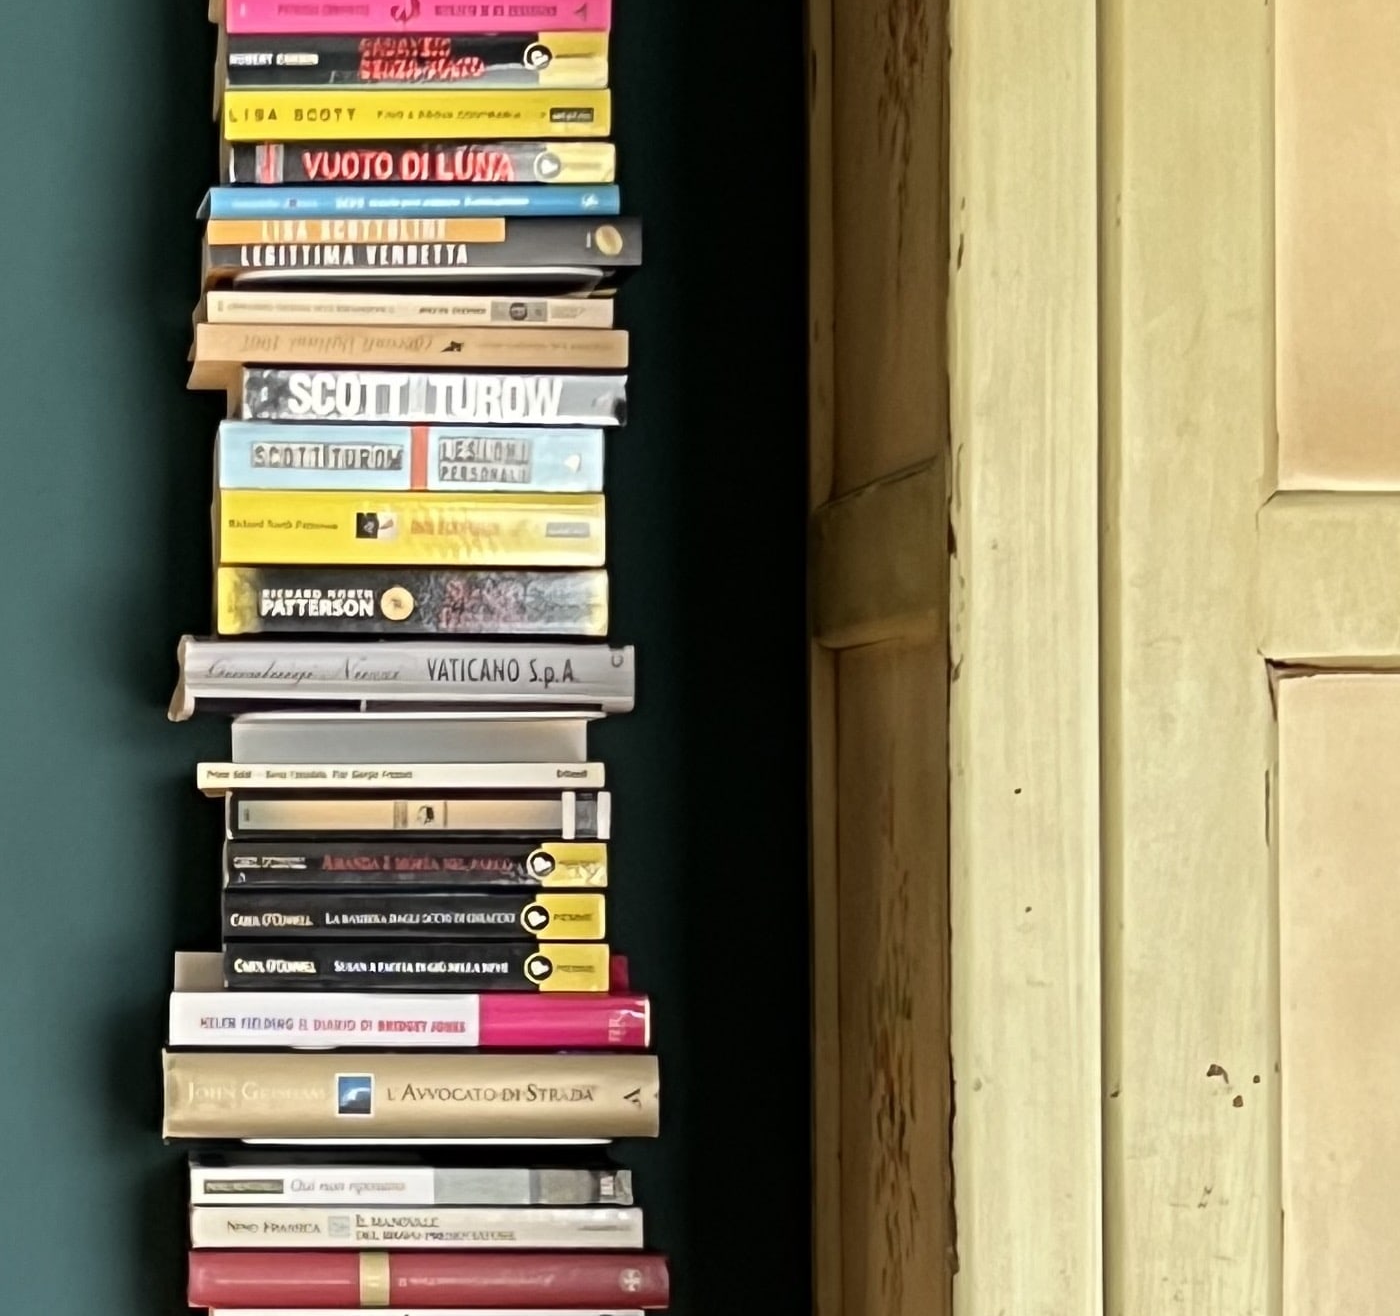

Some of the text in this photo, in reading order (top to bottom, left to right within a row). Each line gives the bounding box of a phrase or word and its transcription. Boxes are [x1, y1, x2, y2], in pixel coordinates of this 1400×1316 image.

[229, 108, 356, 122] LISA SCOTT
[303, 149, 515, 182] VUOTO DI LUNA
[240, 244, 468, 267] LEGITTIMA VENDETTA
[287, 372, 563, 418] SCOTT TUROW
[254, 445, 404, 470] SCOTT TUROW
[440, 465, 528, 483] PERSONALI
[260, 598, 374, 617] PATTERSON
[427, 658, 520, 682] VATICANO
[200, 1017, 236, 1029] HELEN
[241, 1017, 294, 1030] FIELDING
[313, 1019, 356, 1031] DIARIO
[360, 1020, 372, 1031] DI
[502, 1088, 520, 1102] DI
[525, 1083, 594, 1102] STRADA
